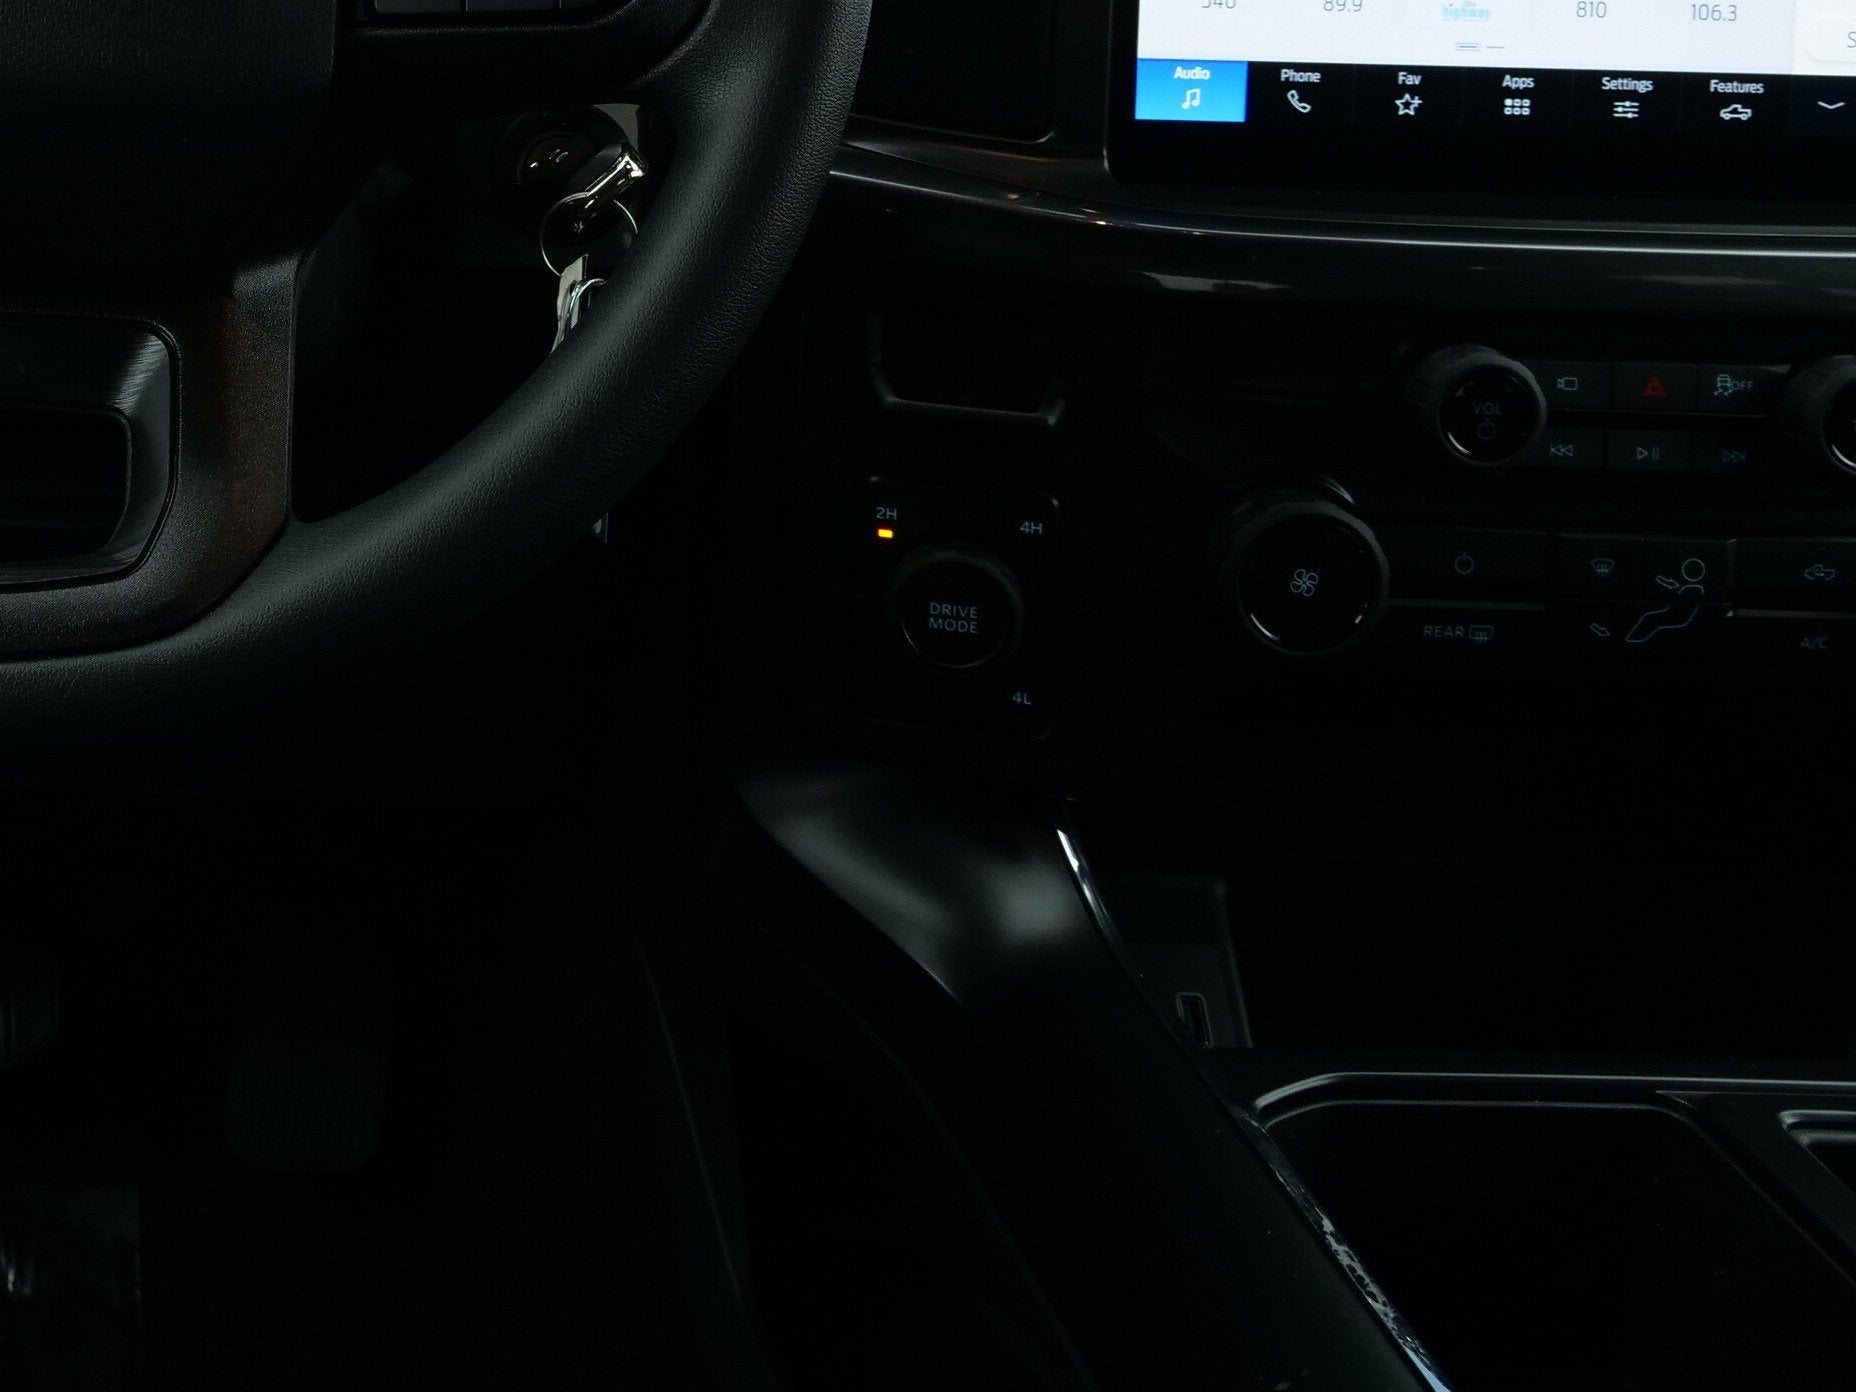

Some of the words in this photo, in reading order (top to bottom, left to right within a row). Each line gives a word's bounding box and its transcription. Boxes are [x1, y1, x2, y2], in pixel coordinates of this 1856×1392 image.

[1576, 1, 1607, 18] 810
[1691, 3, 1738, 21] 106.3
[1173, 66, 1210, 80] Audio
[1280, 69, 1321, 83] Phone
[1397, 72, 1422, 85] Fav
[1502, 74, 1535, 91] Apps
[1601, 77, 1654, 93] Settings
[1709, 79, 1765, 94] Features
[1472, 401, 1503, 415] VOL
[875, 507, 898, 520] 2H
[1020, 521, 1043, 534] 4H
[929, 603, 978, 619] DRIVE
[929, 618, 979, 634] MODE
[1423, 625, 1464, 639] REAR
[1011, 691, 1032, 705] 4L
